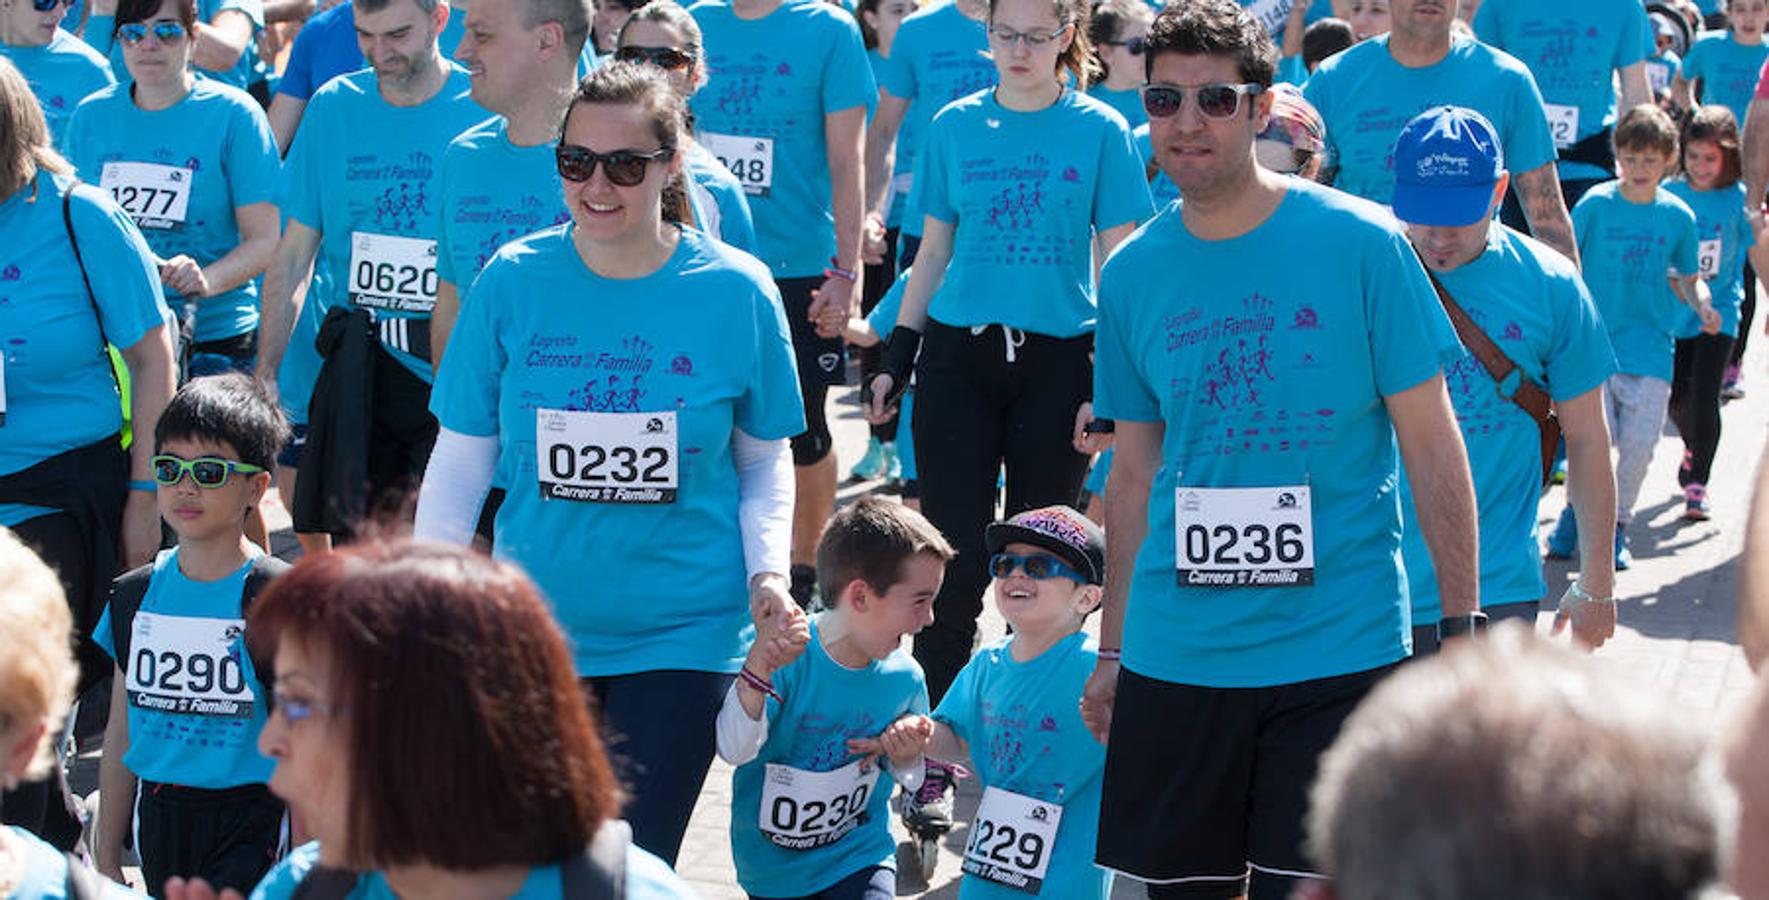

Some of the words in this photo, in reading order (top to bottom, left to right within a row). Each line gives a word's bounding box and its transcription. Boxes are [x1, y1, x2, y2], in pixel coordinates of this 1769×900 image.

[112, 187, 178, 215] 1277
[357, 261, 441, 297] 0620
[526, 351, 582, 368] Carrera
[595, 353, 653, 372] Familia
[550, 443, 669, 482] 0232
[552, 484, 600, 499] Carrera
[614, 487, 663, 501] Familia
[1186, 523, 1304, 565] 0236
[1188, 570, 1234, 584] Carrera
[1249, 570, 1299, 584] Familia
[135, 648, 245, 694] 0290
[137, 693, 176, 711] Carrera
[190, 699, 239, 714] Familia
[772, 784, 868, 832] 0230
